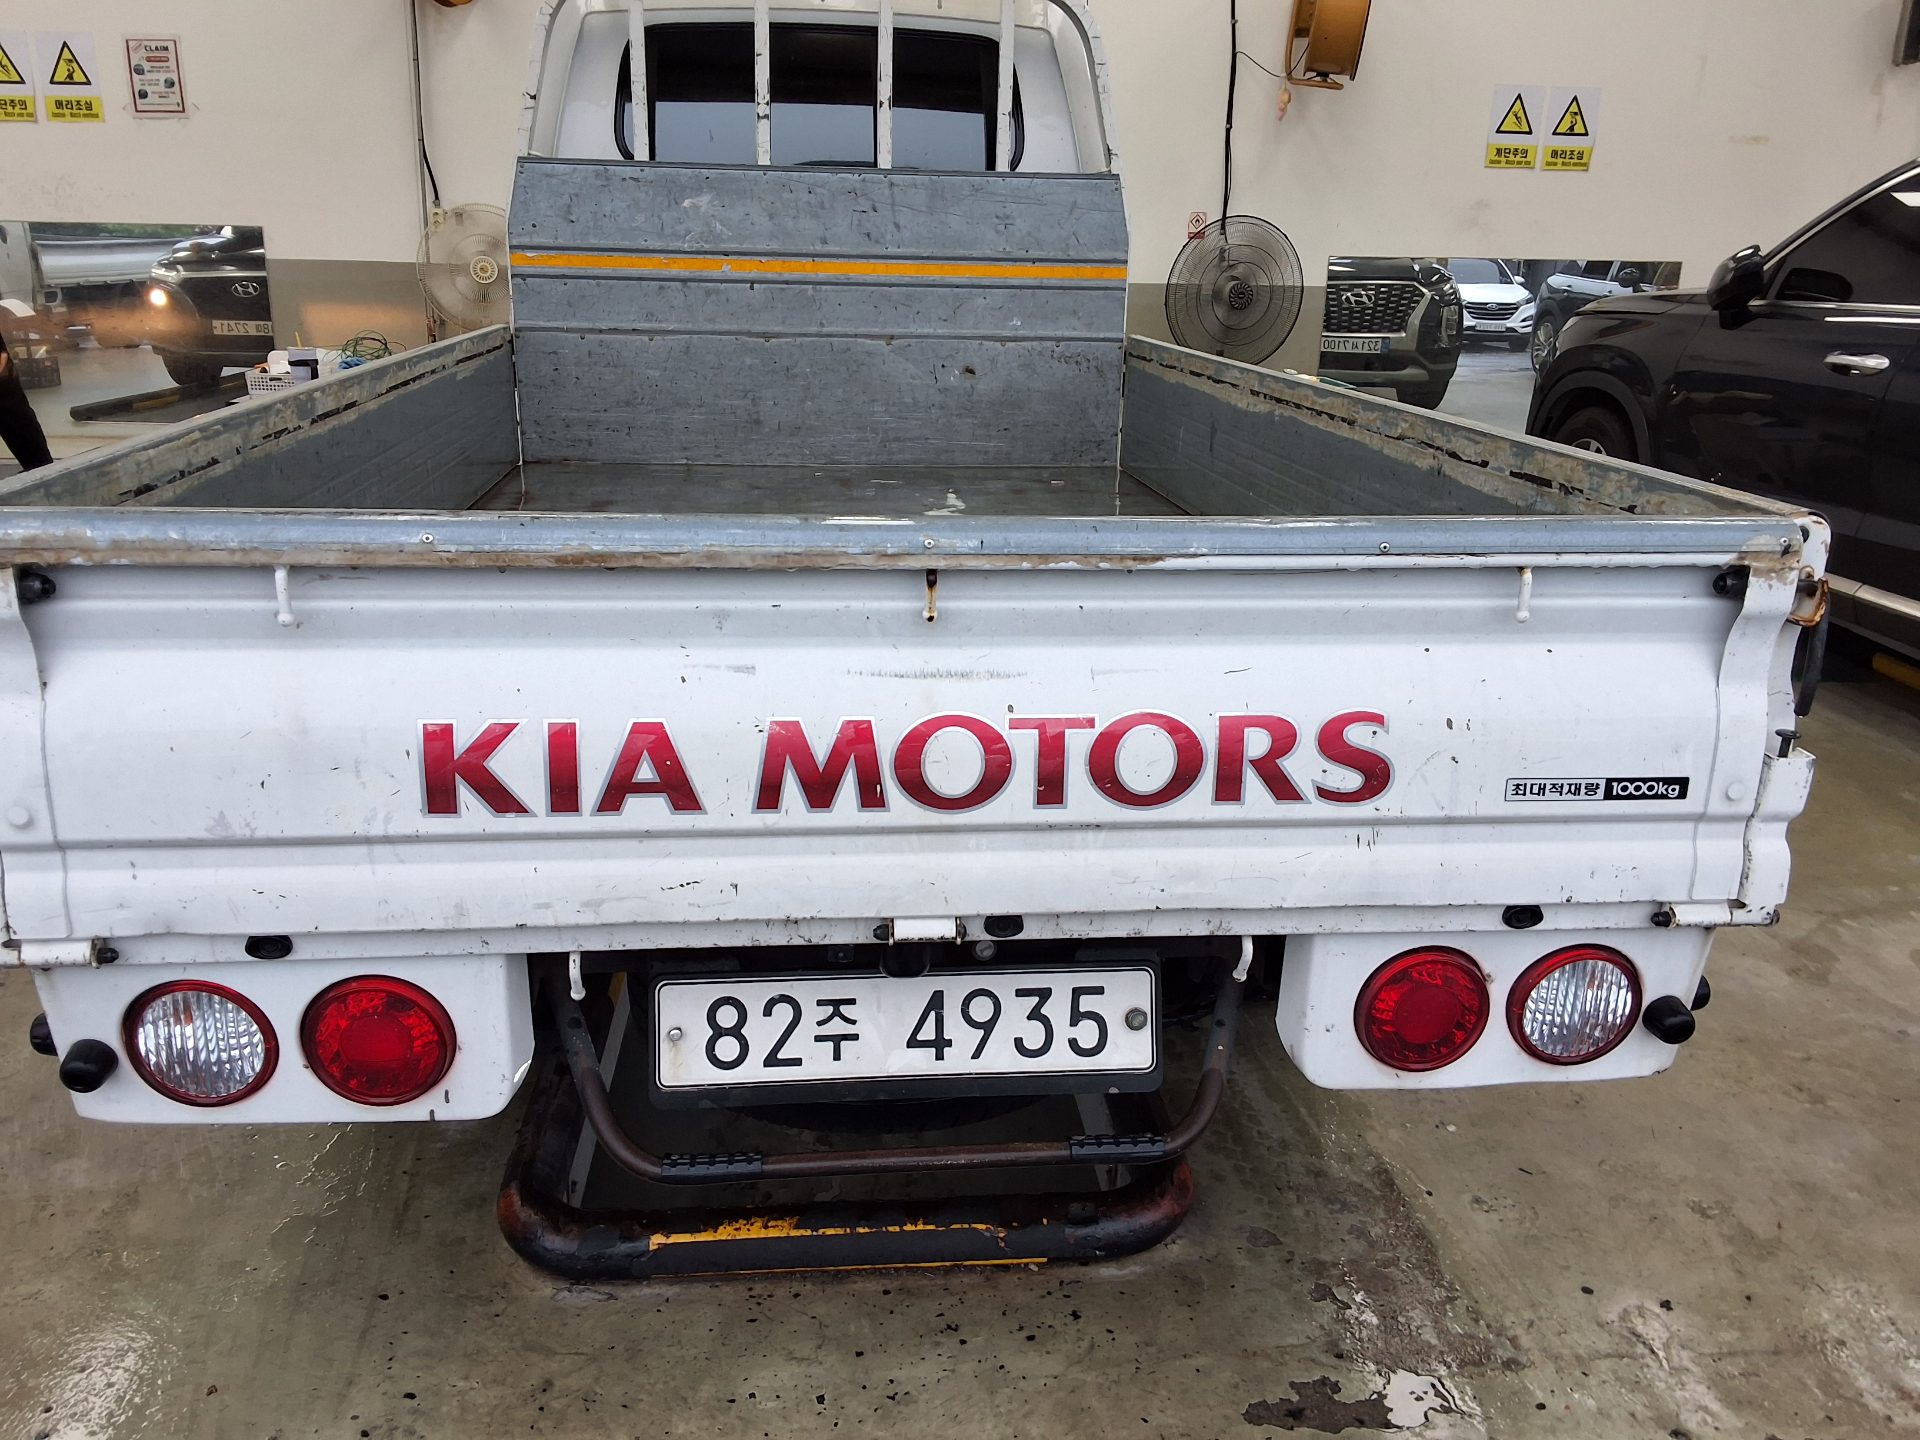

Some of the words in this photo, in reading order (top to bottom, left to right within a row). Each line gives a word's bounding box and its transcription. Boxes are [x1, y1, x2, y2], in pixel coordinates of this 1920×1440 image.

[54, 99, 93, 111] 머리조심
[1494, 147, 1529, 159] 계단주의
[1550, 149, 1585, 161] 머리조심
[417, 715, 707, 818] KIA
[751, 707, 1394, 815] MOTORS
[1510, 782, 1600, 797] 최대적재량
[1611, 781, 1680, 798] 1000kg
[705, 993, 859, 1071] 82주
[906, 985, 1109, 1062] 4935
